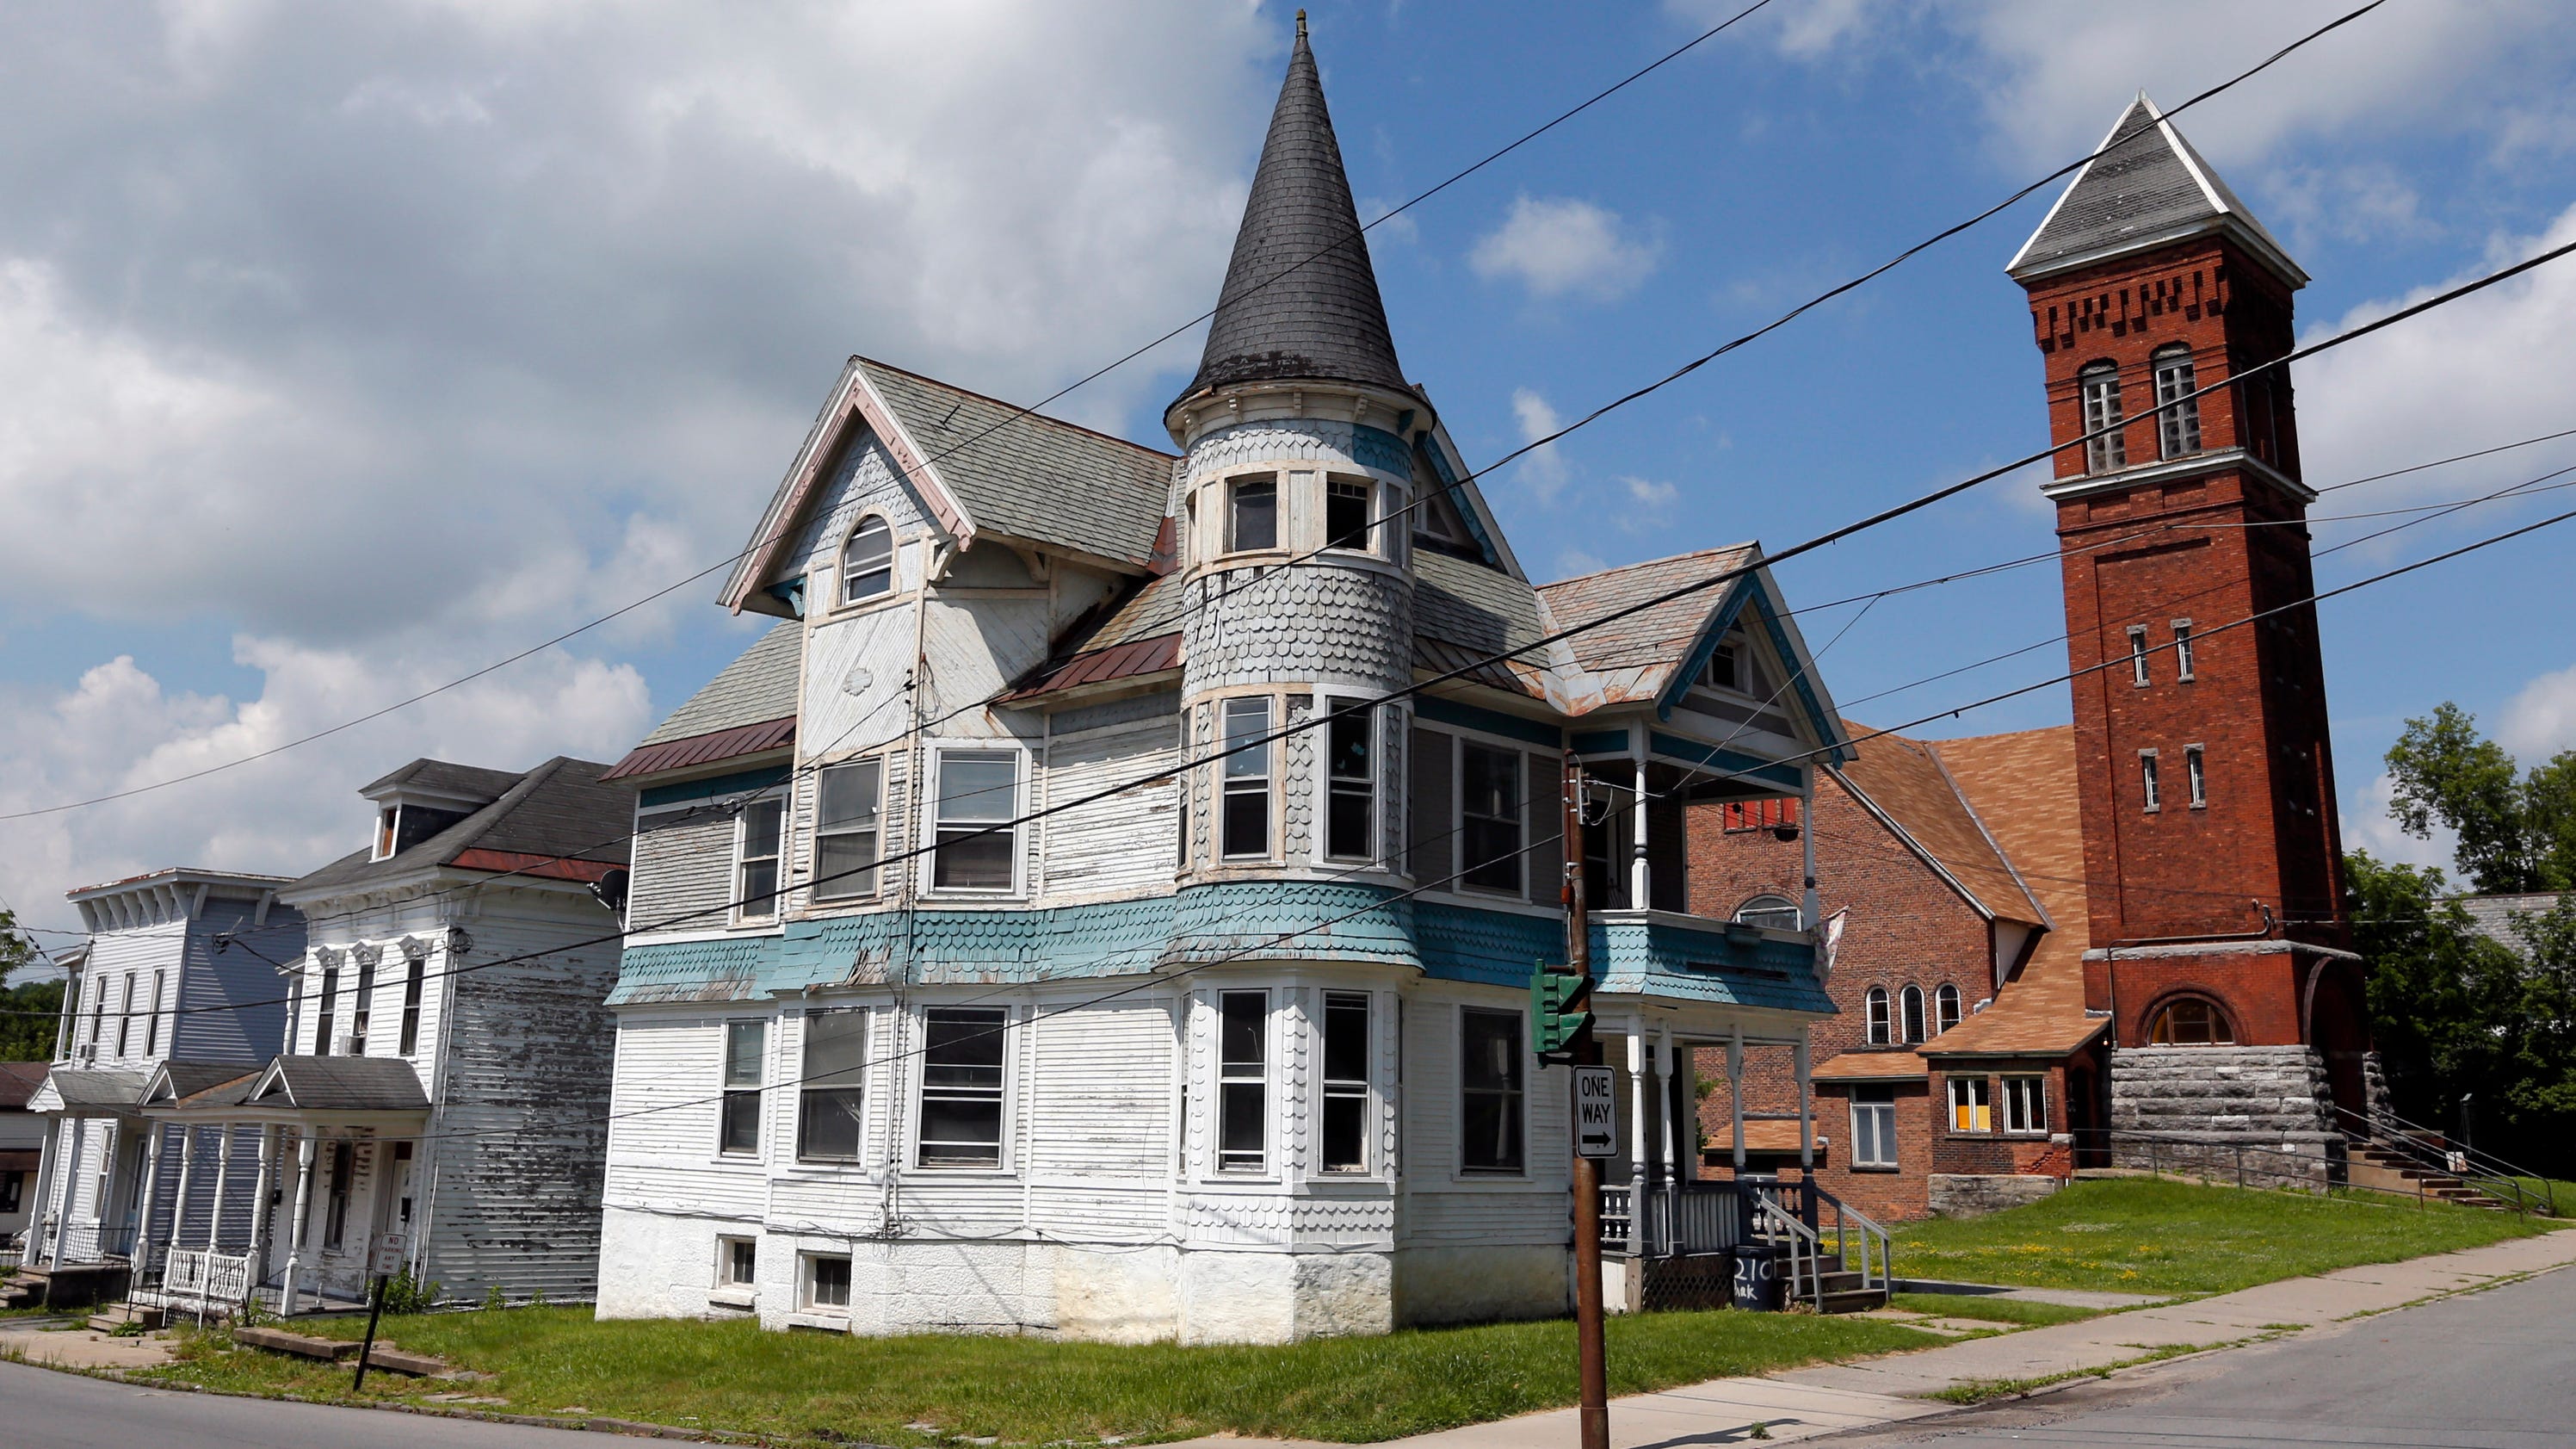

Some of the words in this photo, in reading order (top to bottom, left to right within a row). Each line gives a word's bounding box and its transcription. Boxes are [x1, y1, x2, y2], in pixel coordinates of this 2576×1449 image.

[1582, 1076, 1609, 1097] ONE
[1582, 1103, 1610, 1124] WAY
[388, 1236, 399, 1245] NO
[1734, 1257, 1773, 1281] 210
